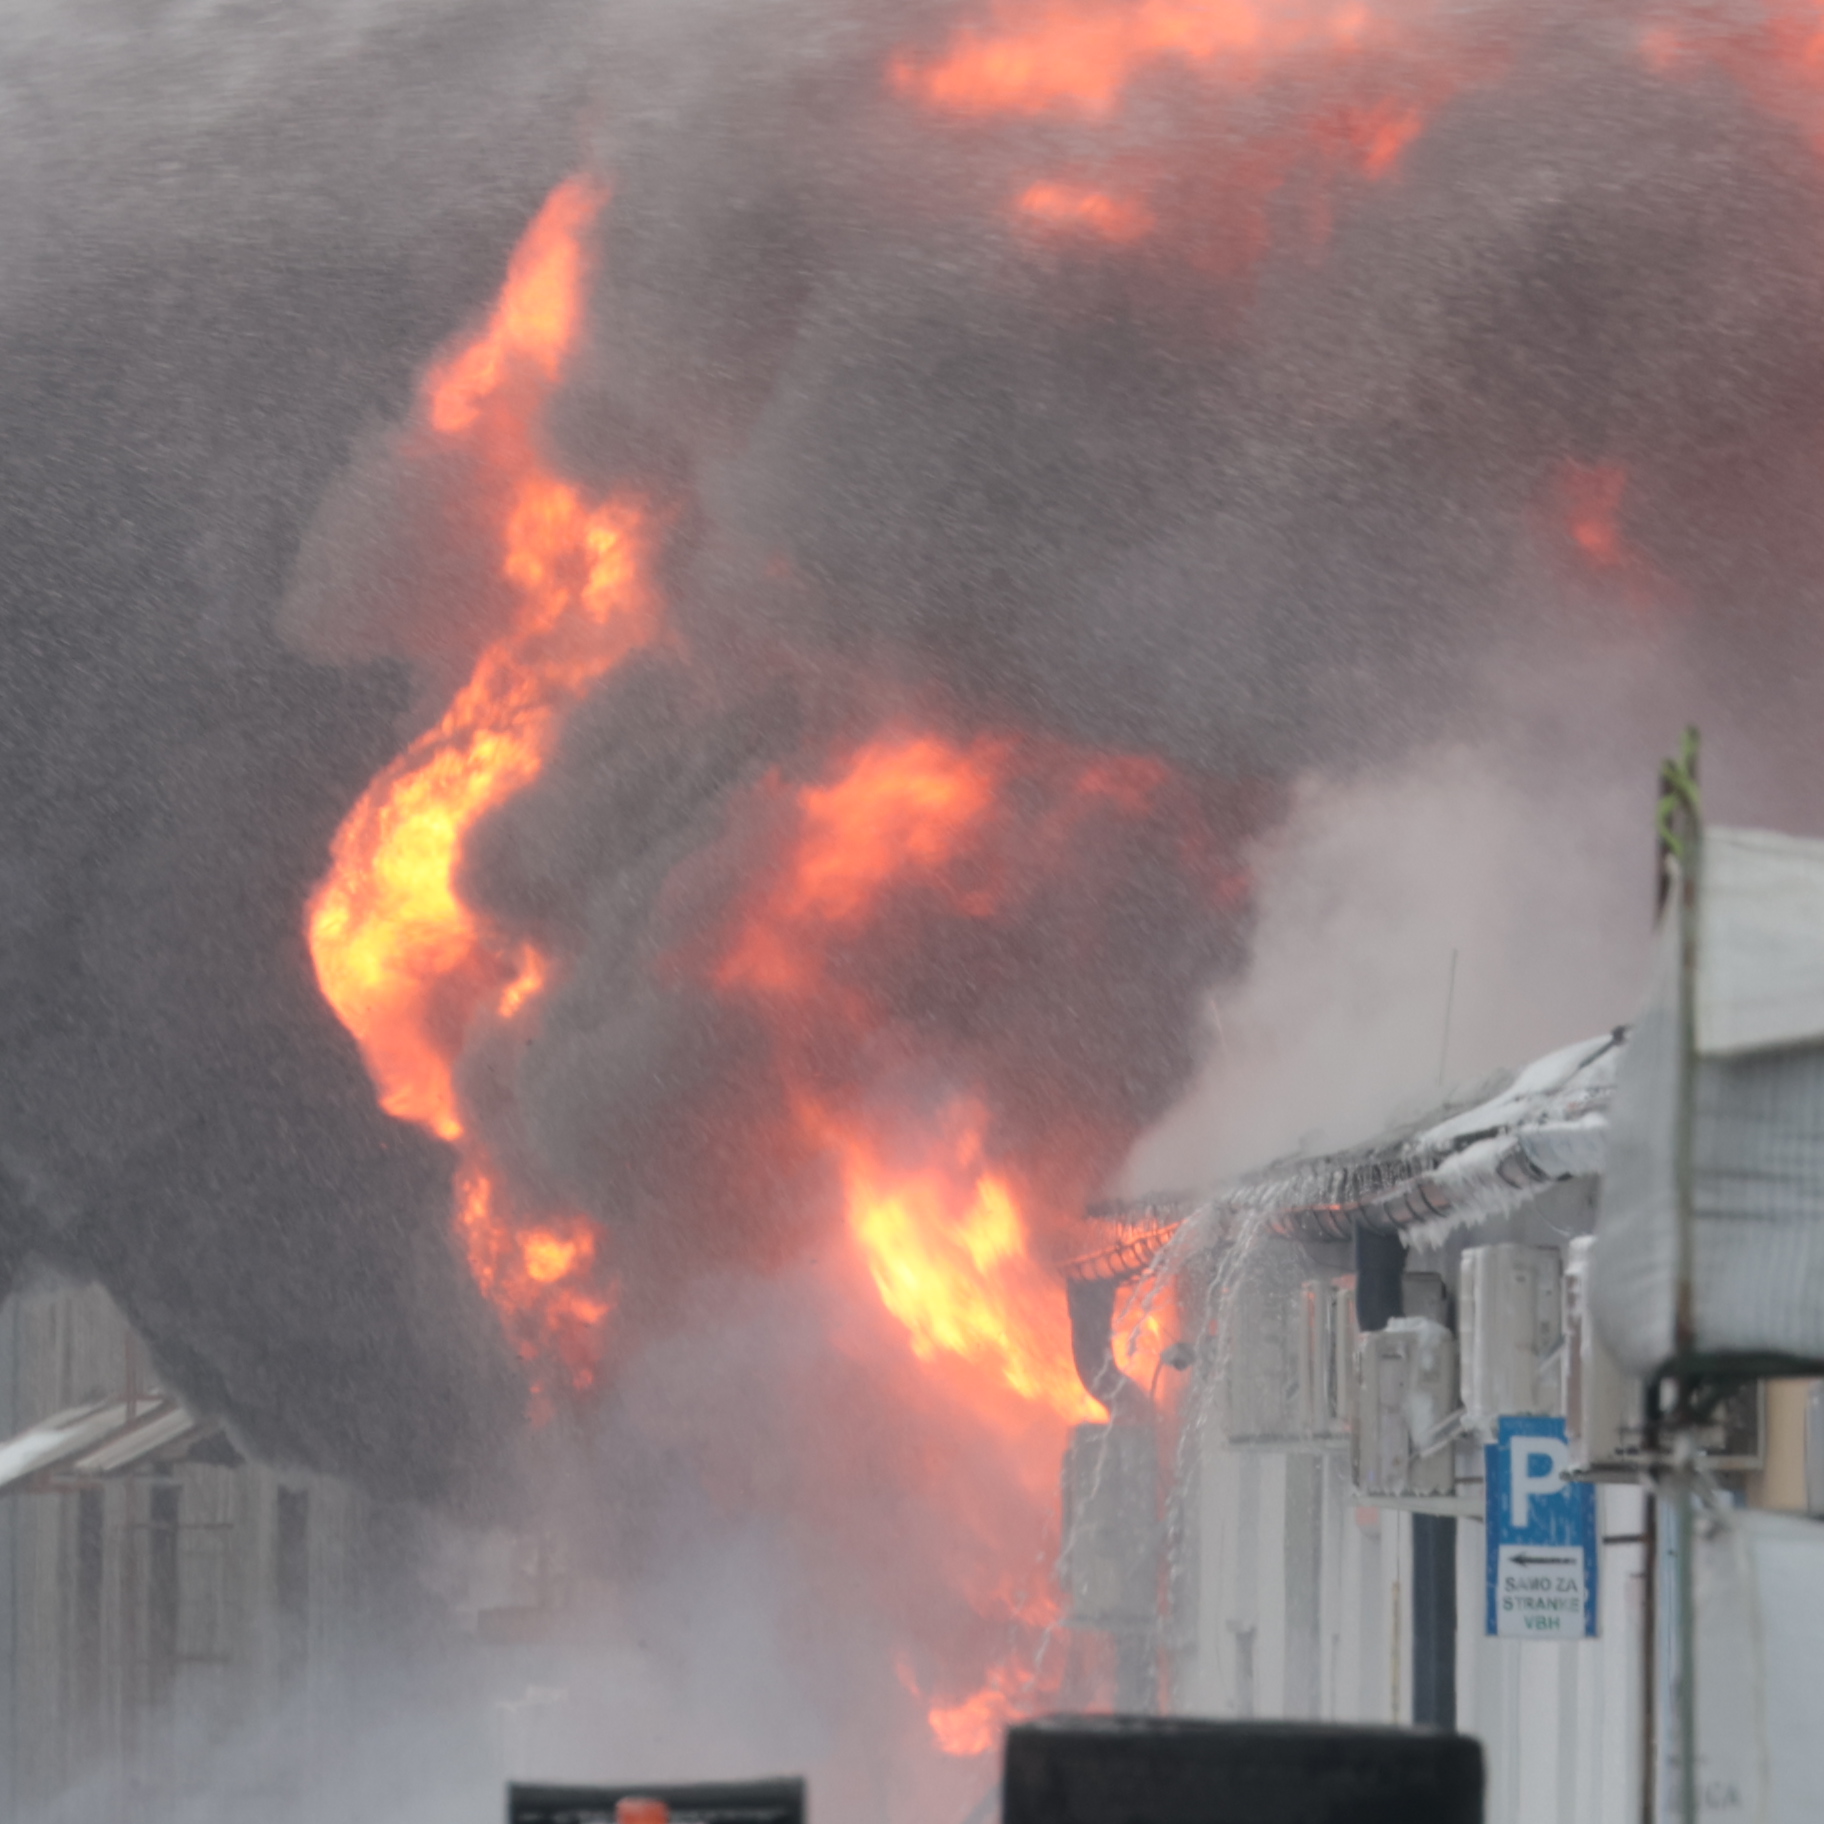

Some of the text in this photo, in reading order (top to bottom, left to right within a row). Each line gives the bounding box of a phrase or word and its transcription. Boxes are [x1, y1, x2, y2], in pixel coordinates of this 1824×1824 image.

[1510, 1436, 1569, 1528] P
[1504, 1576, 1578, 1593] SAMO ZA
[1502, 1596, 1580, 1612] STRANKE
[1523, 1615, 1561, 1631] VBH
